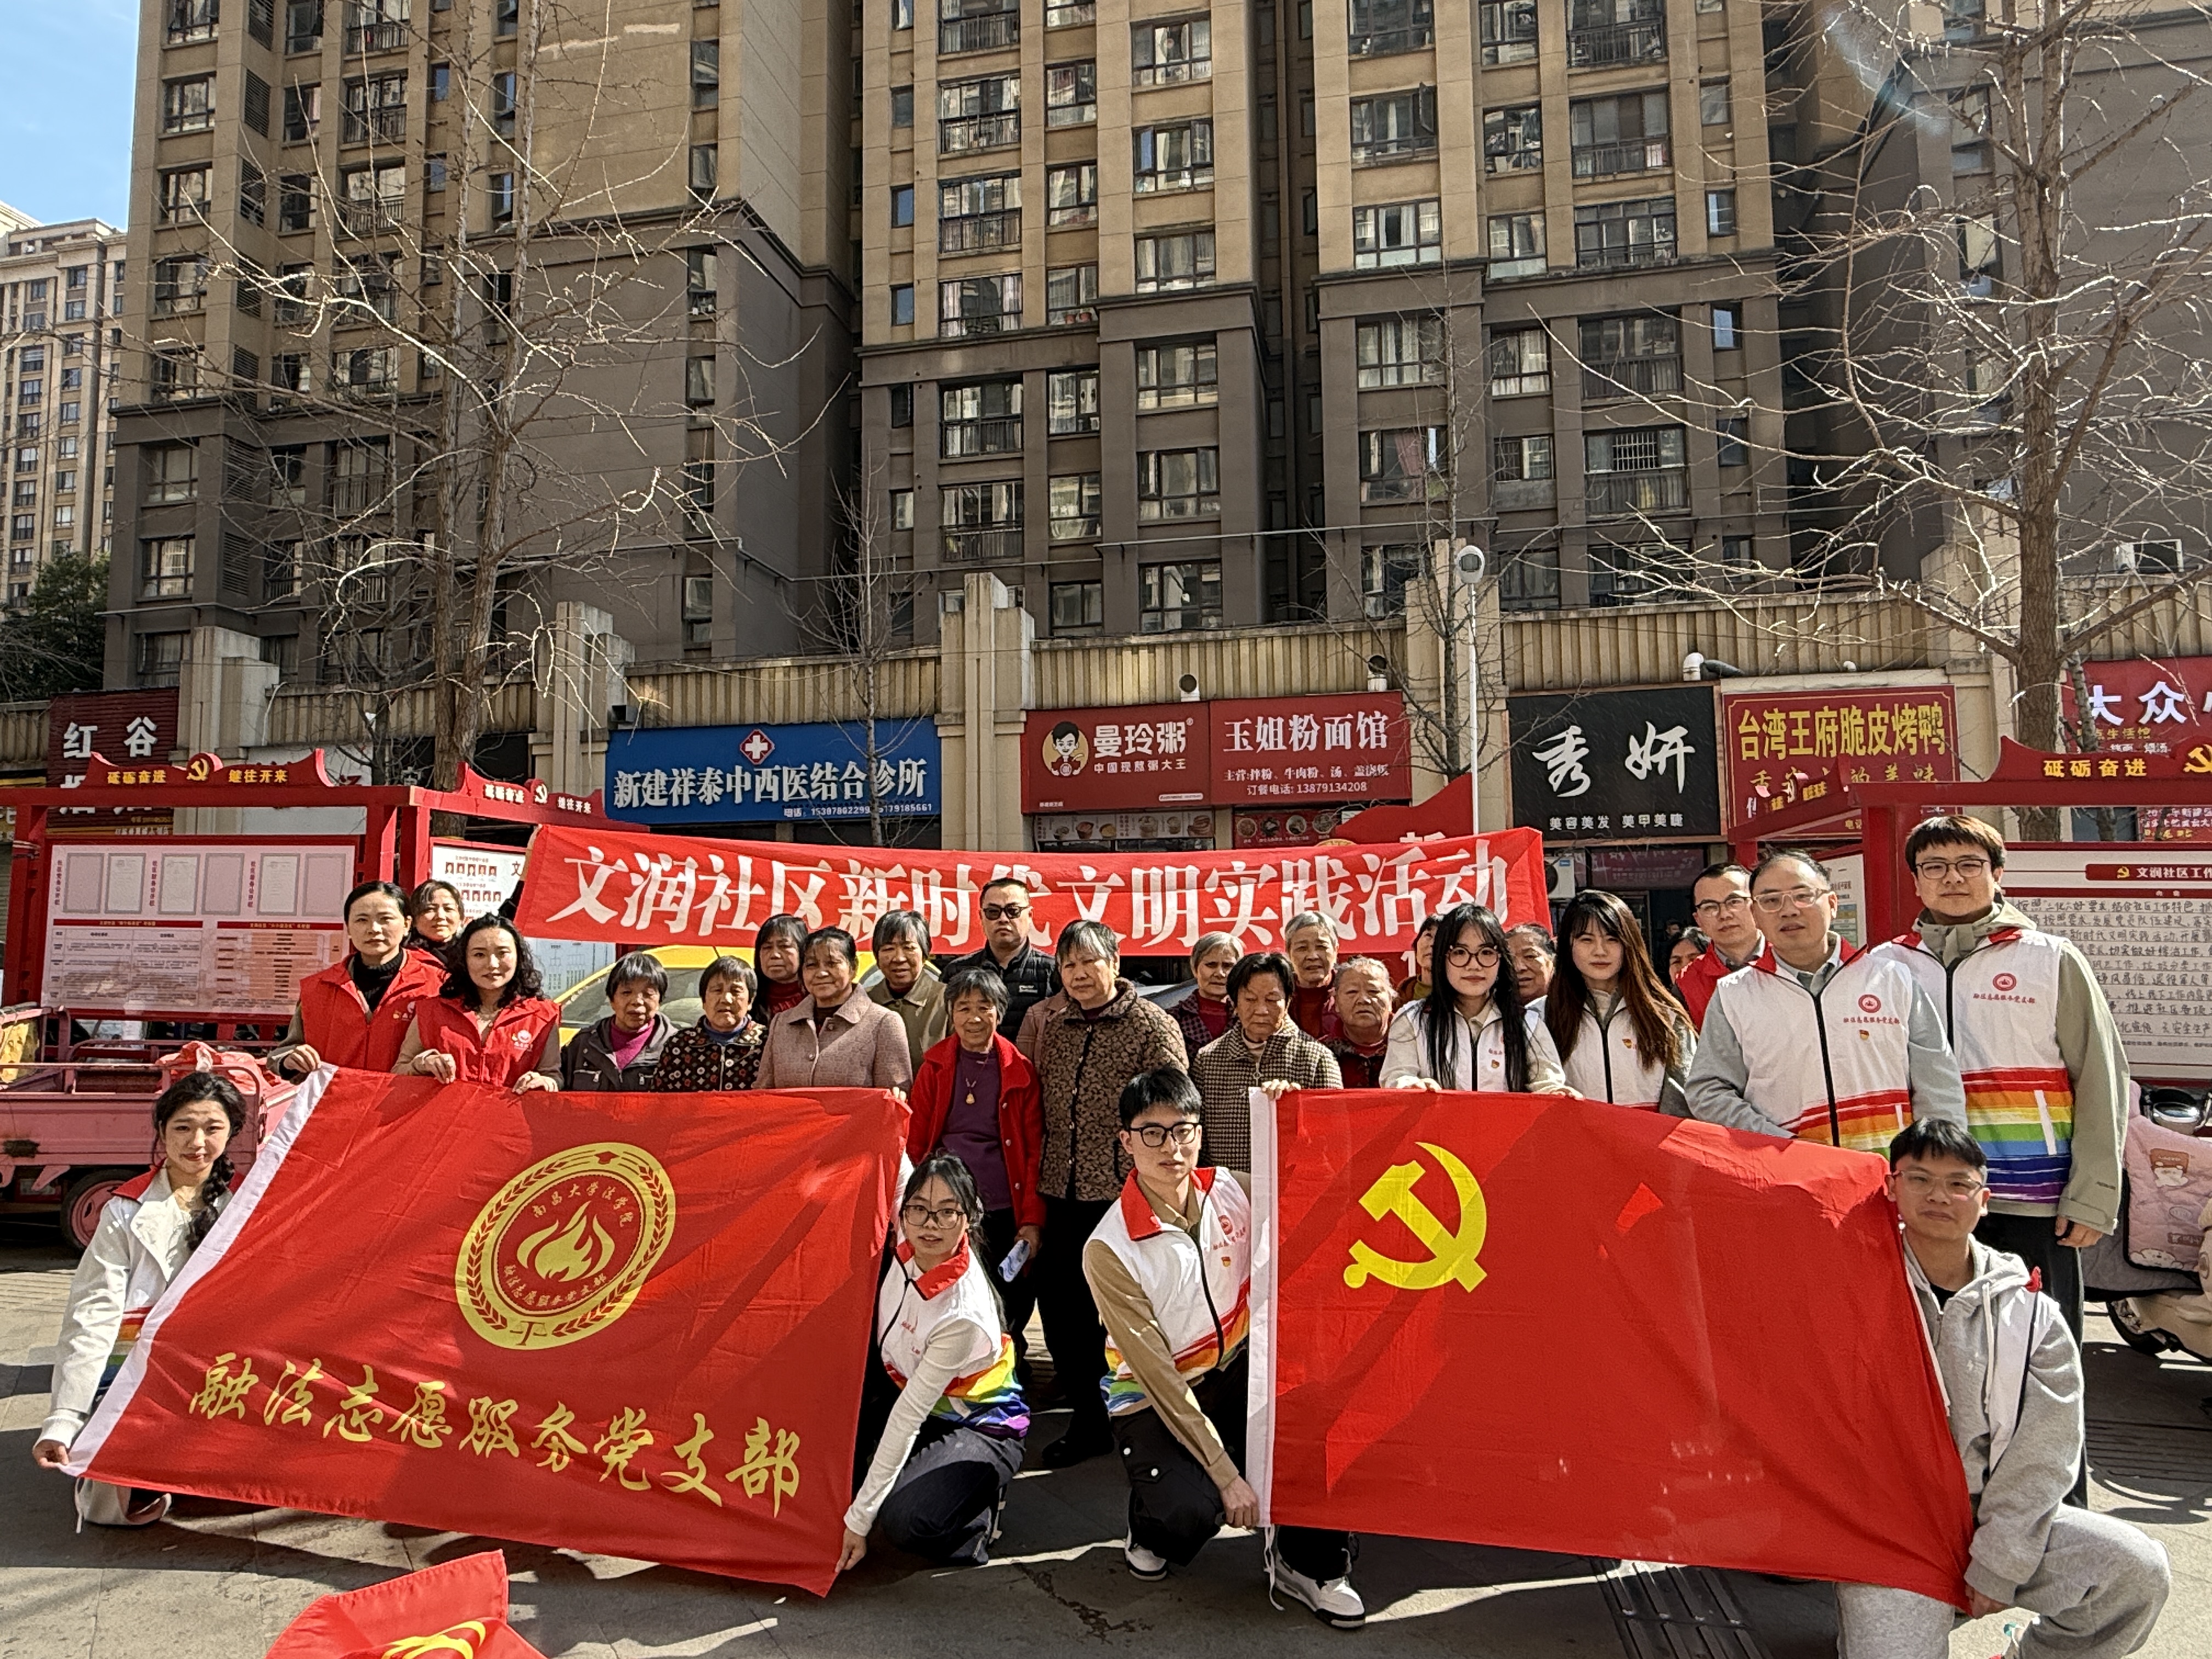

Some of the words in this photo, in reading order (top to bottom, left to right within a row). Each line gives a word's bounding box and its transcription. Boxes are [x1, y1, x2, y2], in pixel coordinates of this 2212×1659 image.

[2078, 681, 2212, 726] 大众
[63, 716, 158, 759] 红谷
[1093, 720, 1186, 758] 曼玲粥
[1223, 711, 1389, 753] 玉姐粉面馆
[1738, 701, 1945, 760] 台湾王府脆皮烤鸭
[228, 769, 289, 783] 继往开来
[614, 757, 928, 809] 新建祥泰中西医结合诊所
[1297, 781, 1367, 793] 13879134208
[2043, 758, 2147, 778] 砥砺奋进
[873, 803, 932, 813] 5179185661
[1549, 815, 1610, 831] 美容美发
[189, 1351, 801, 1519] 融法志愿服务党支部
